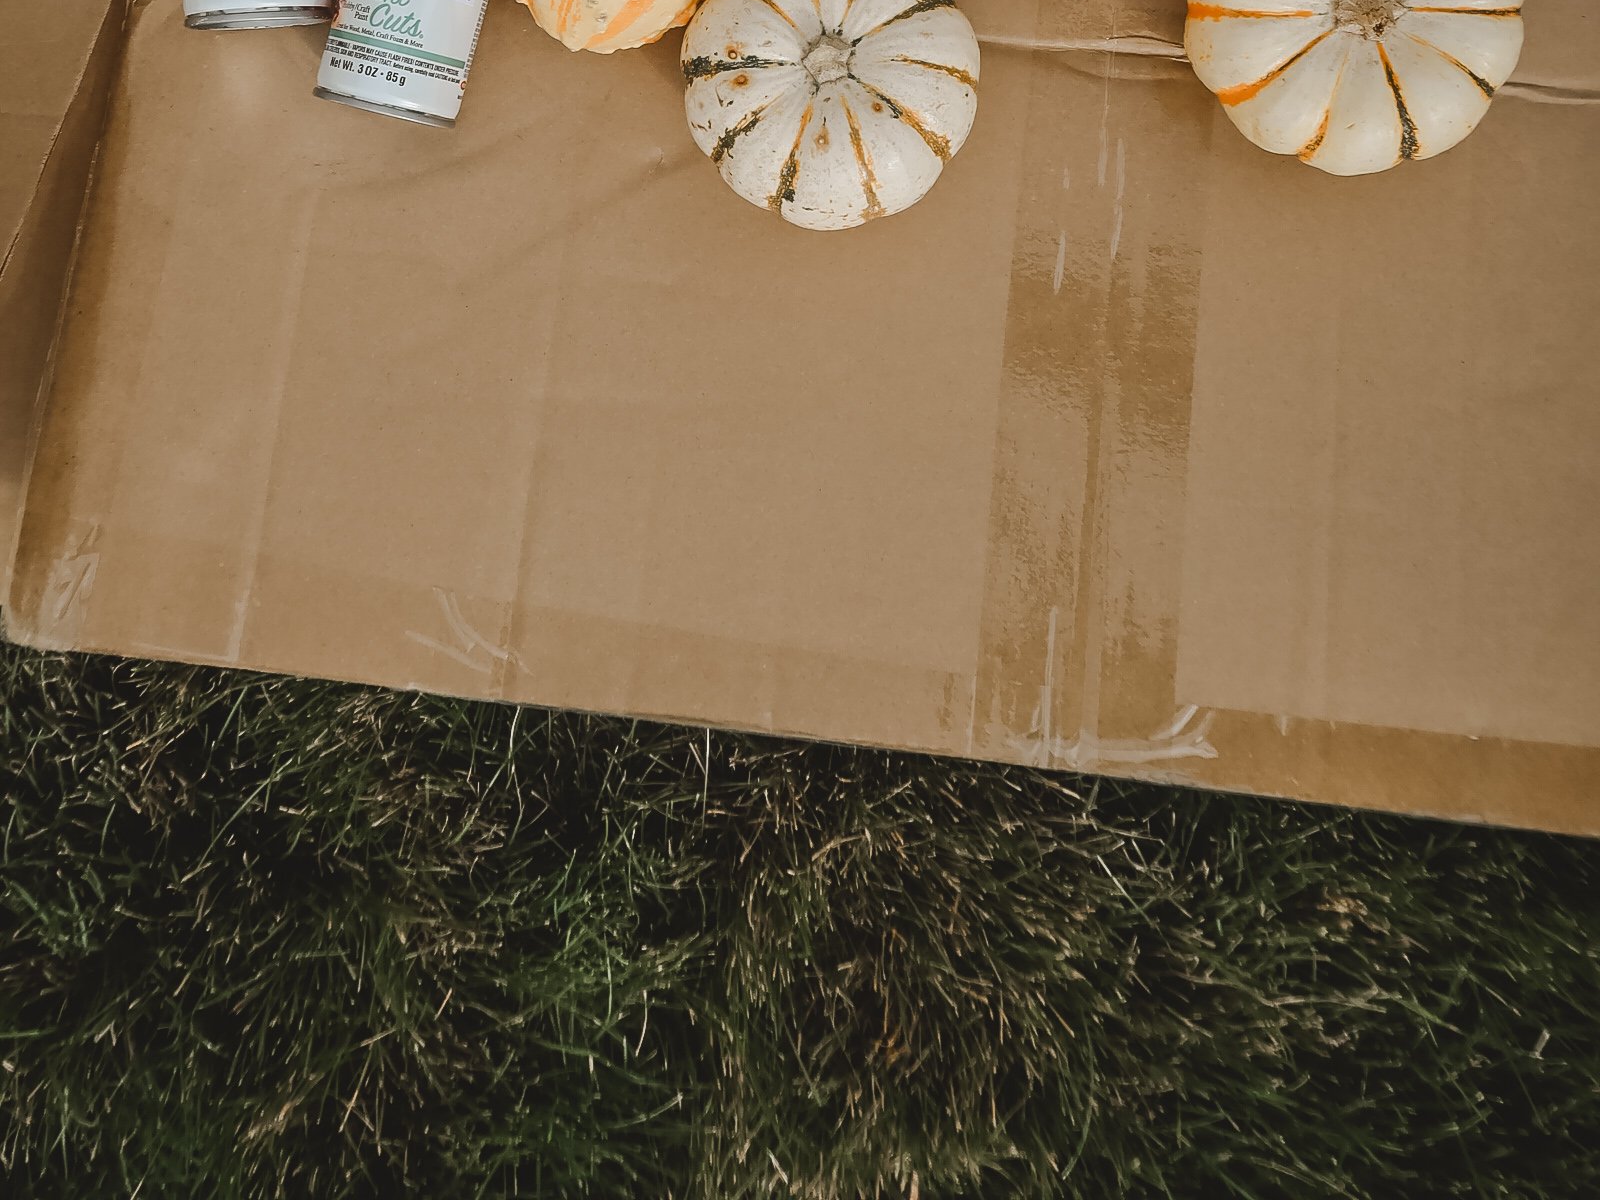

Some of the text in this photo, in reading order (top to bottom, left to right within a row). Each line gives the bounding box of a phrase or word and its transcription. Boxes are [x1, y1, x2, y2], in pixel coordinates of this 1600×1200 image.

[354, 11, 368, 21] Paint
[369, 3, 421, 37] Cuts
[376, 31, 390, 40] Craft
[410, 40, 423, 48] More
[330, 56, 341, 69] Net
[342, 59, 355, 72] Wt.
[357, 64, 364, 74] 3
[365, 66, 379, 78] OZ
